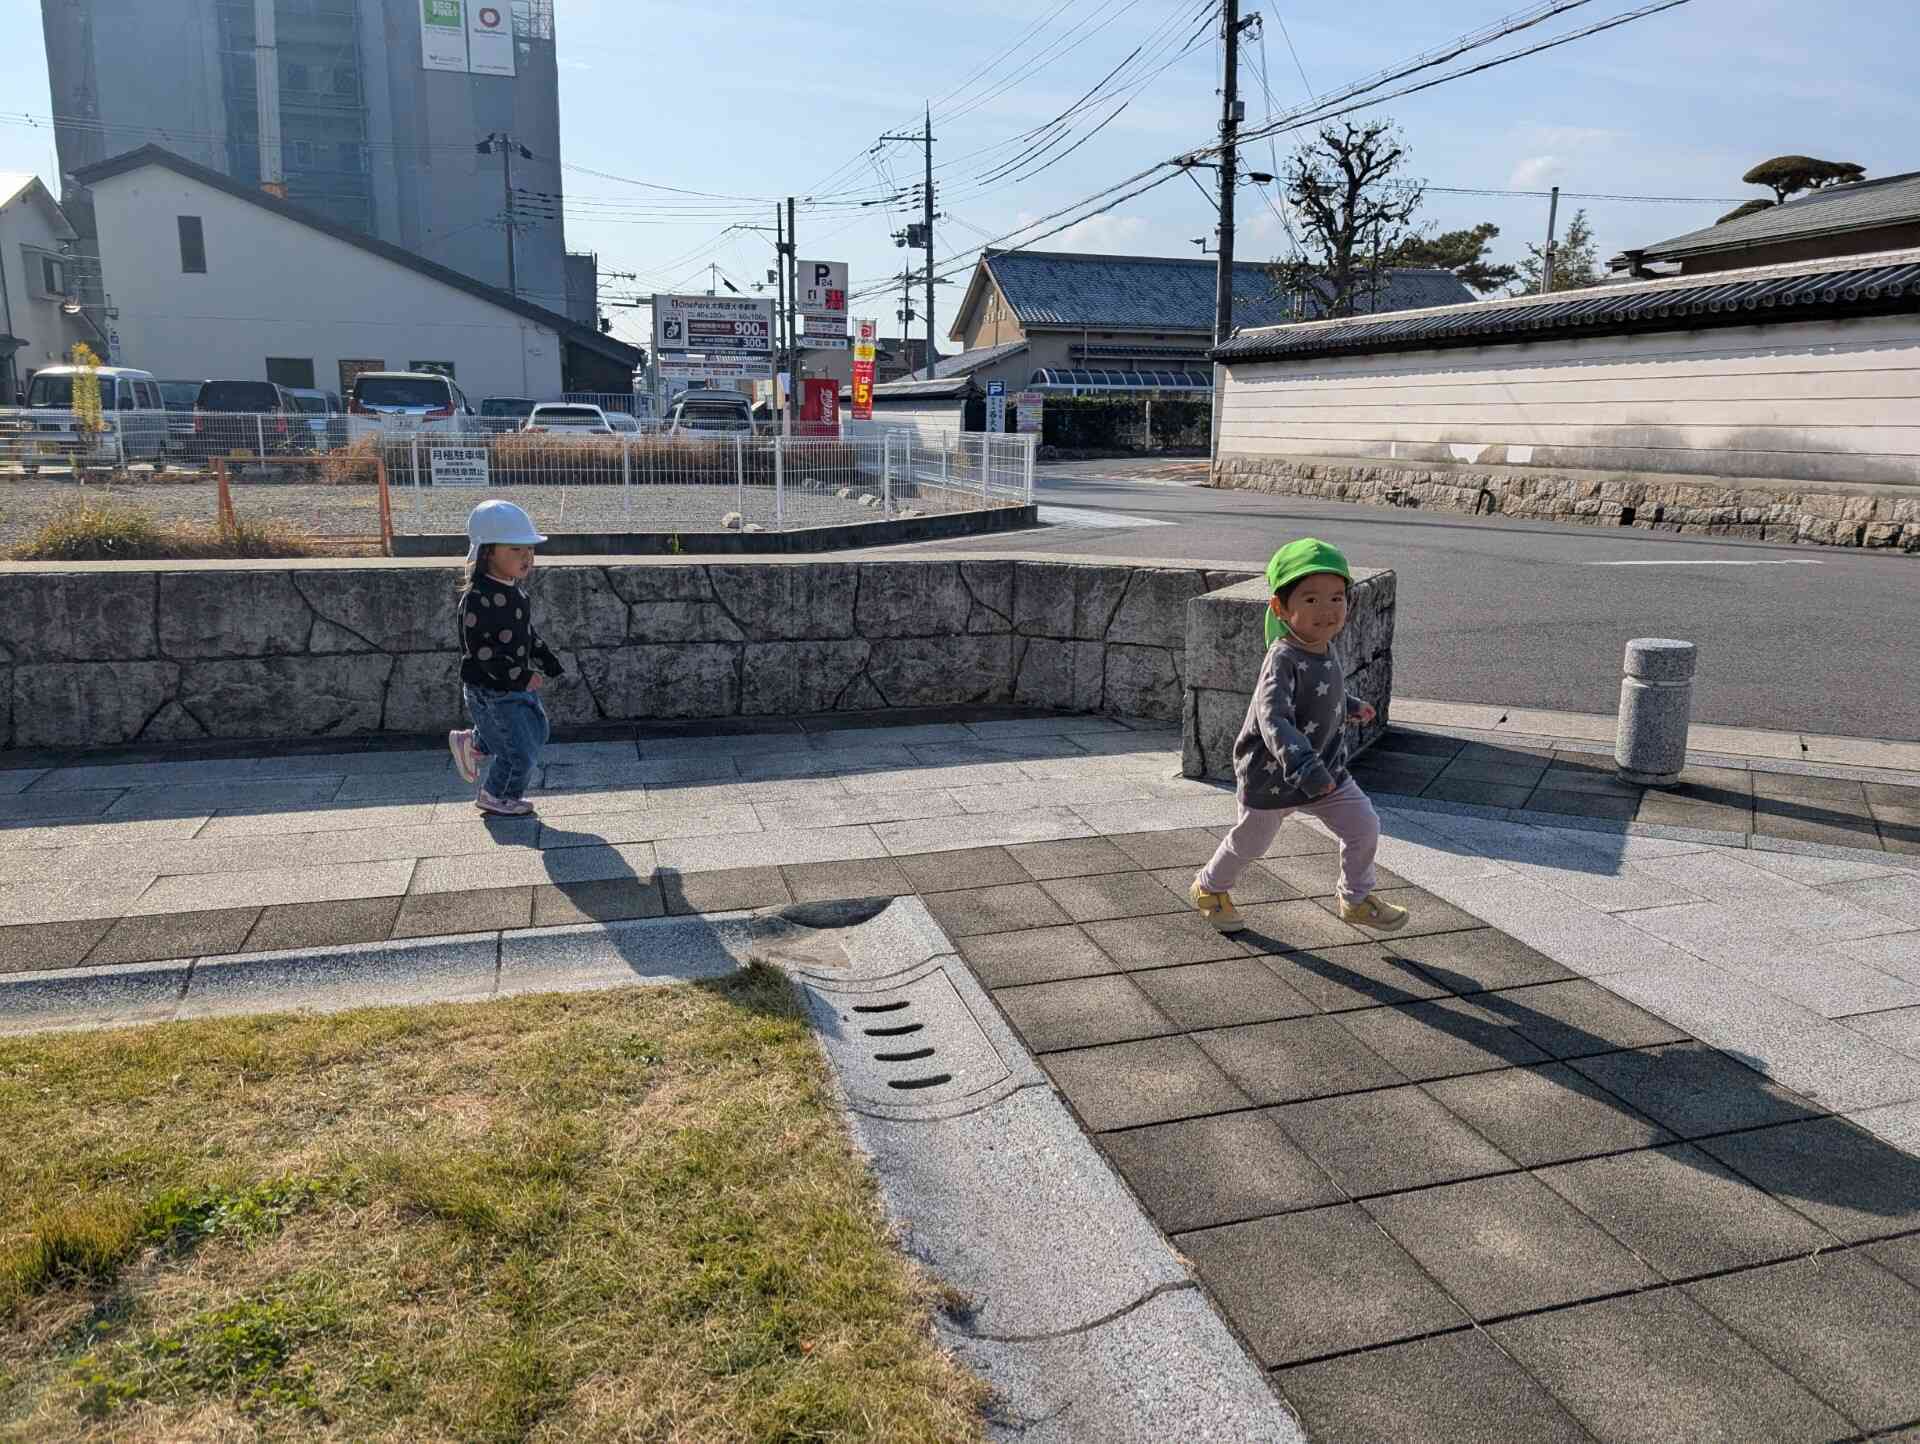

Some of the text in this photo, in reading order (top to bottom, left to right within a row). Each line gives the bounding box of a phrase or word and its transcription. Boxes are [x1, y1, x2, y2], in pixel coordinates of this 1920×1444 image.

[815, 264, 831, 286] P
[734, 322, 767, 337] 900円
[990, 382, 1002, 394] P
